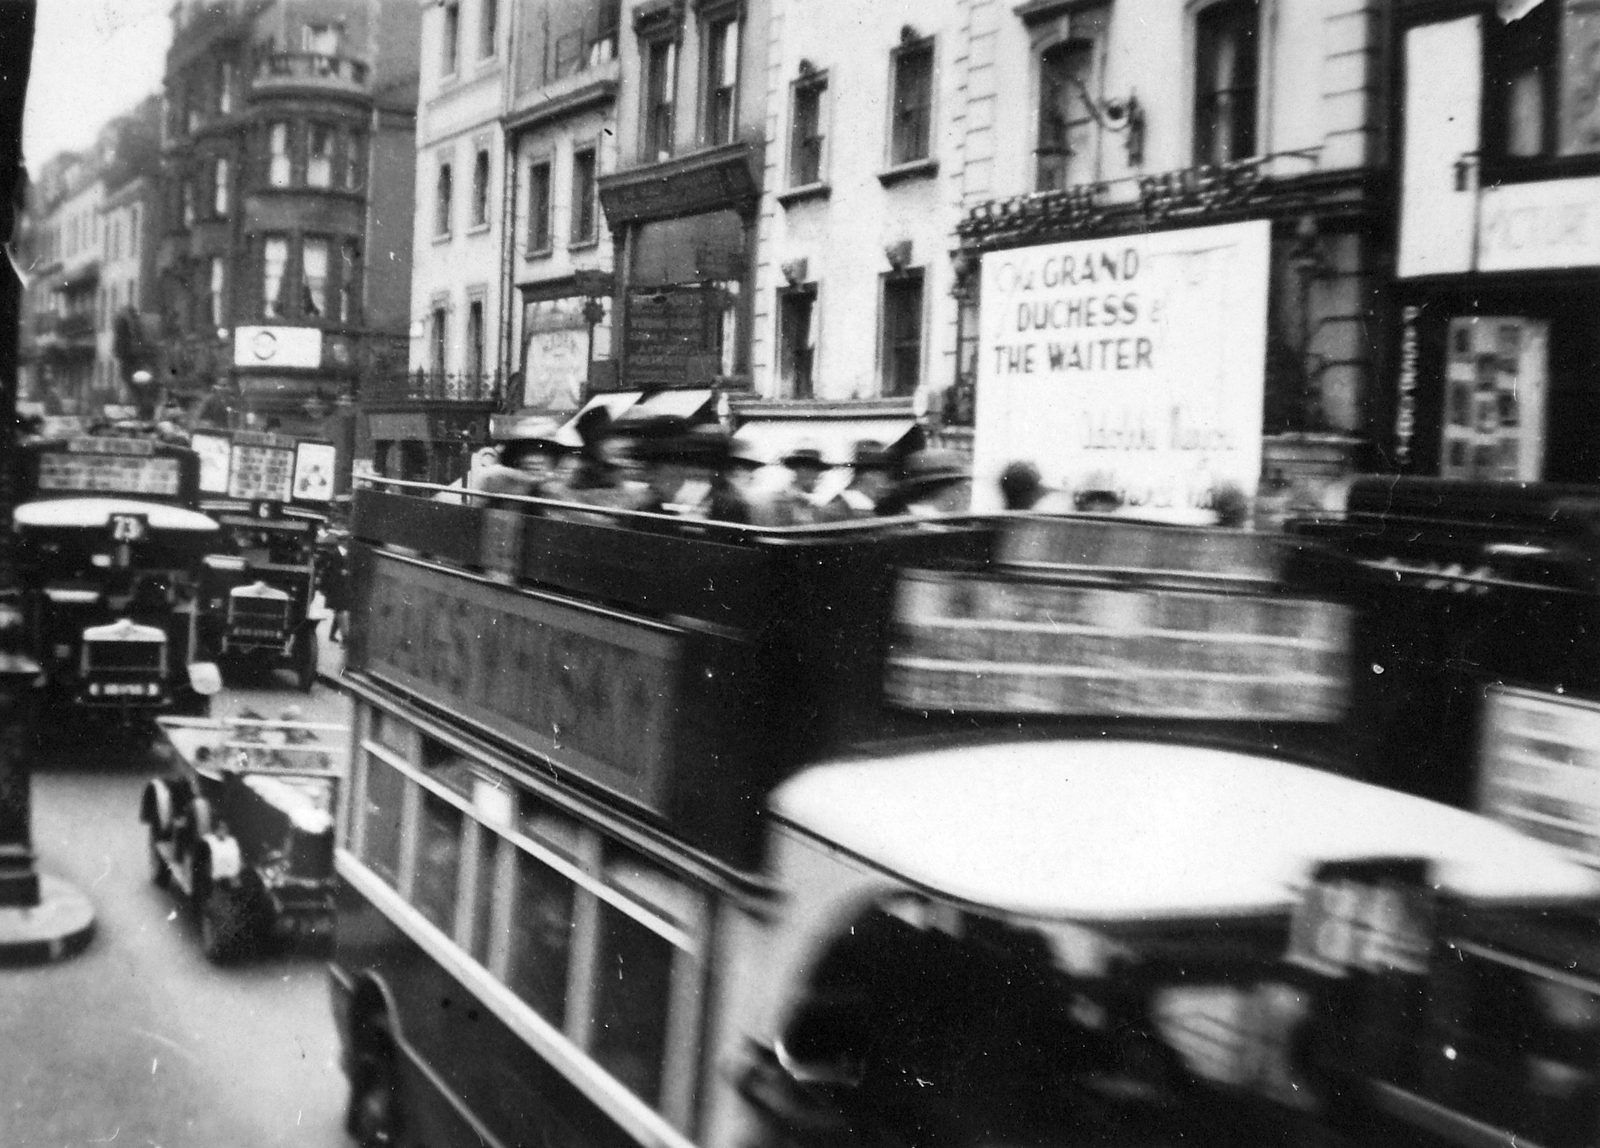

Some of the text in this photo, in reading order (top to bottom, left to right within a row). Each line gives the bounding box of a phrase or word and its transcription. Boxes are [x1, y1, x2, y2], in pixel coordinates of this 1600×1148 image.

[1043, 248, 1139, 287] GRAND
[1017, 293, 1138, 332] DUCHESS
[994, 337, 1153, 374] THE WAITER
